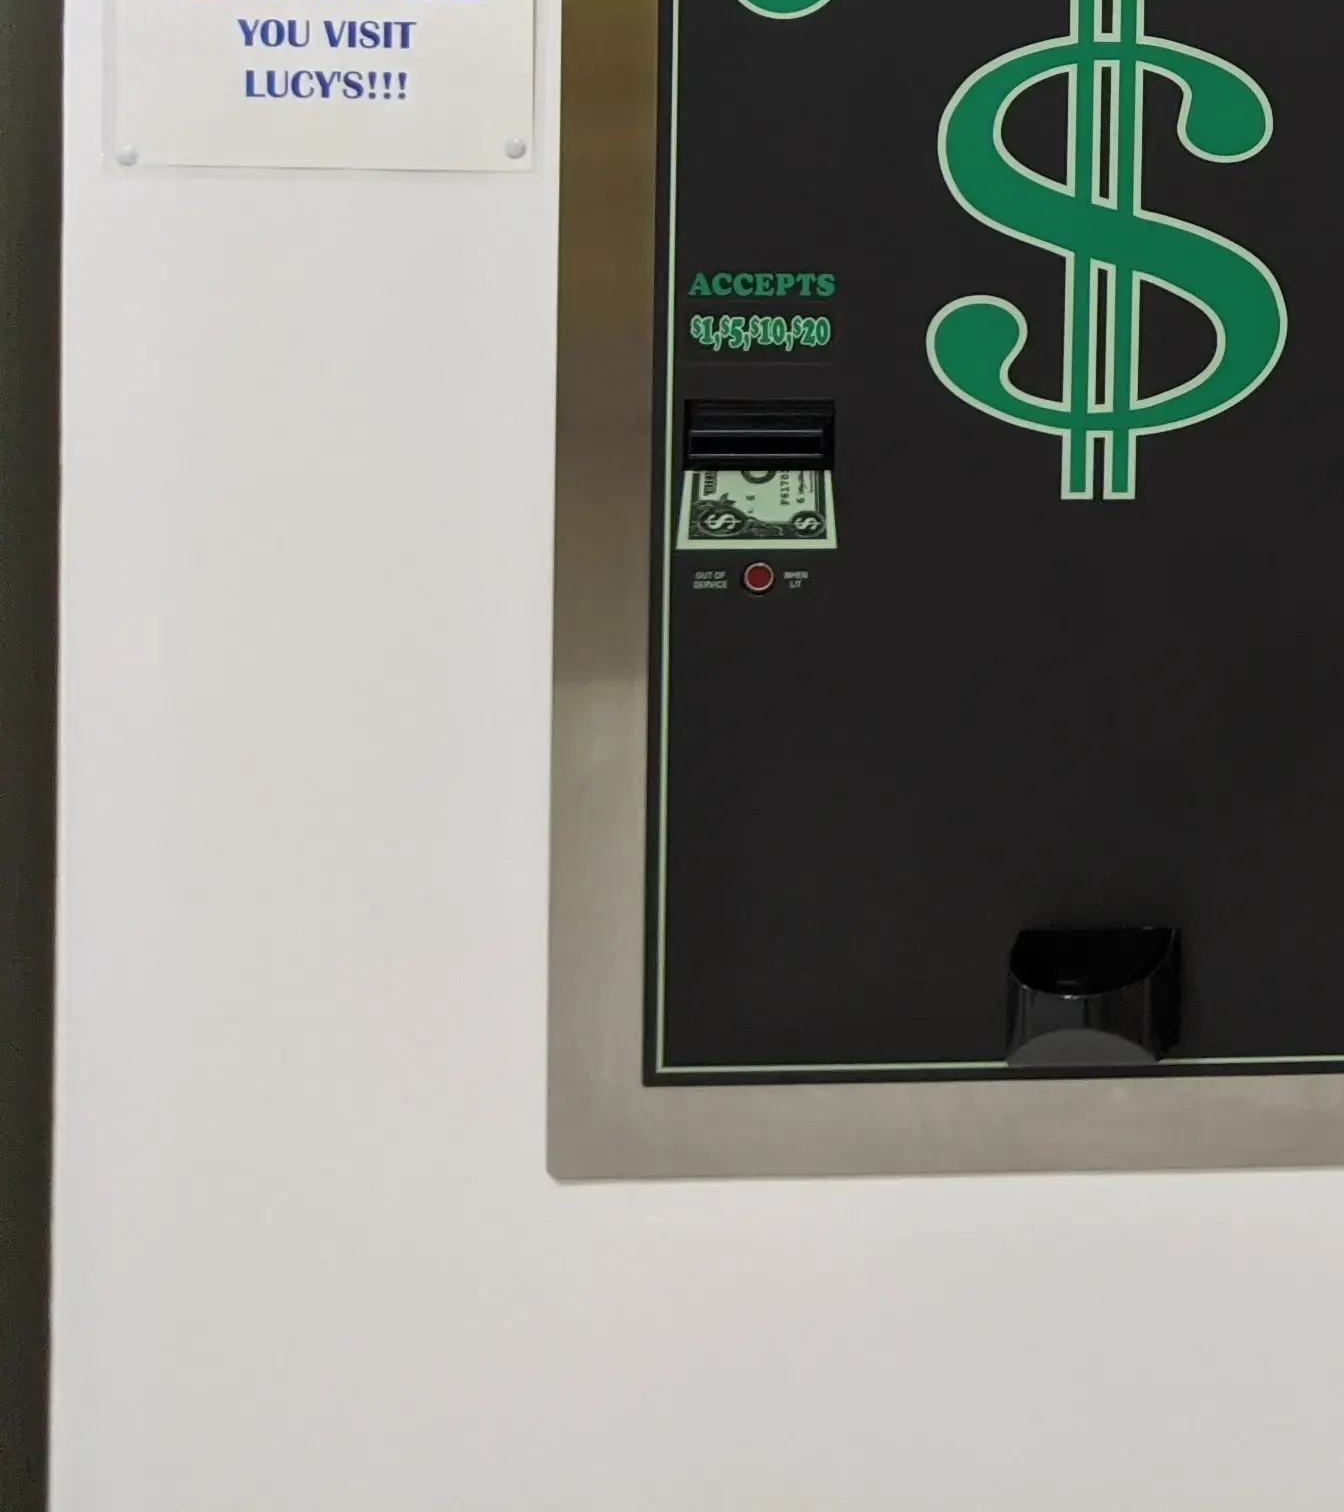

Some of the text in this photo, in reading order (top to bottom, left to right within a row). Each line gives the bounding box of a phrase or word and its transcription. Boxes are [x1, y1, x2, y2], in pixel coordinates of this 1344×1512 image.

[237, 19, 417, 49] YOU VISIT
[245, 70, 407, 100] LUCY'S!!!
[688, 273, 836, 296] ACCEPTS
[691, 315, 830, 351] $1,$5,$10,$20
